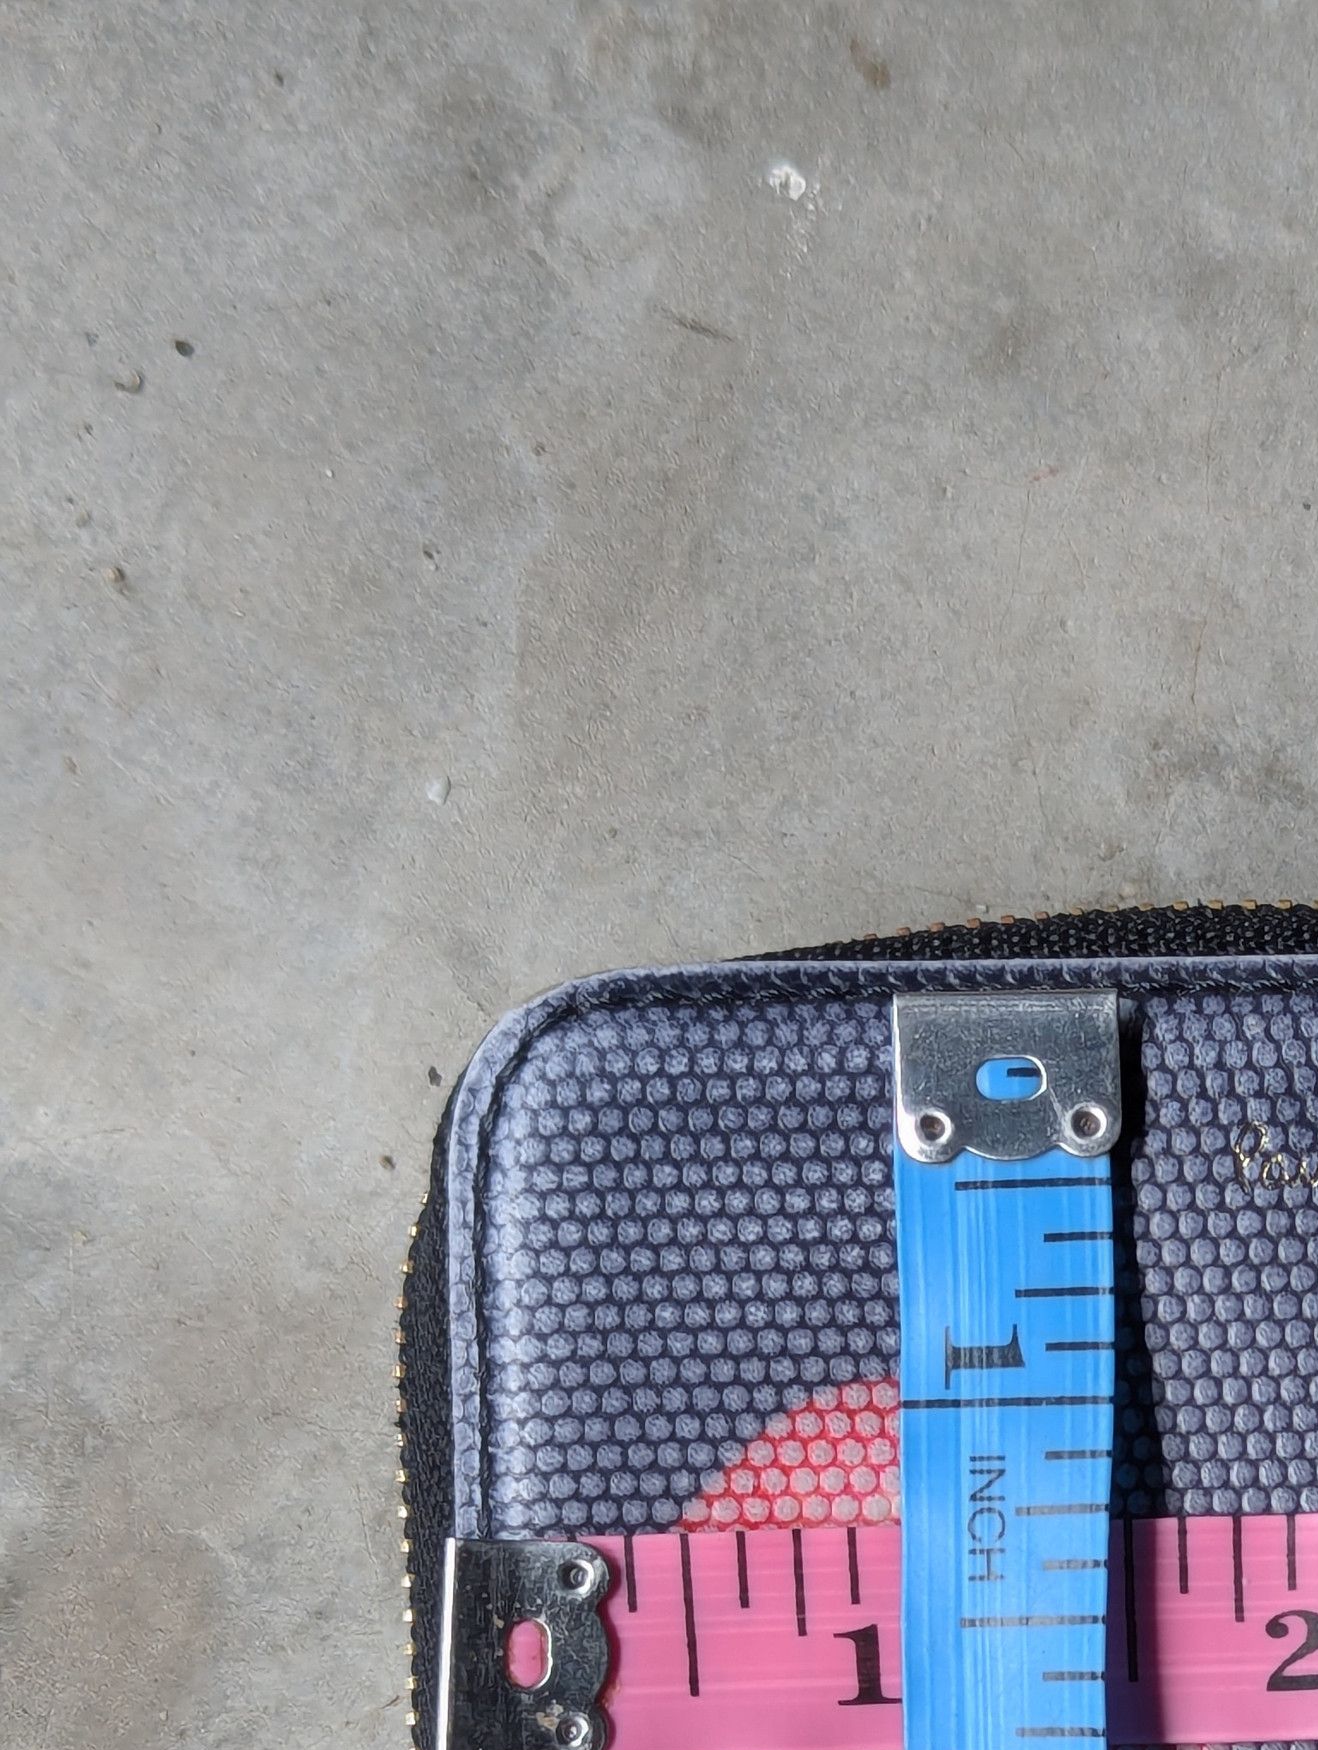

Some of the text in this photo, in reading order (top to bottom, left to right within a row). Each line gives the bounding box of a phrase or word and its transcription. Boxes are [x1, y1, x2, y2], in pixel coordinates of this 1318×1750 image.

[944, 1324, 1026, 1391] 1
[966, 1454, 1007, 1583] INCH
[833, 1623, 903, 1708] 1
